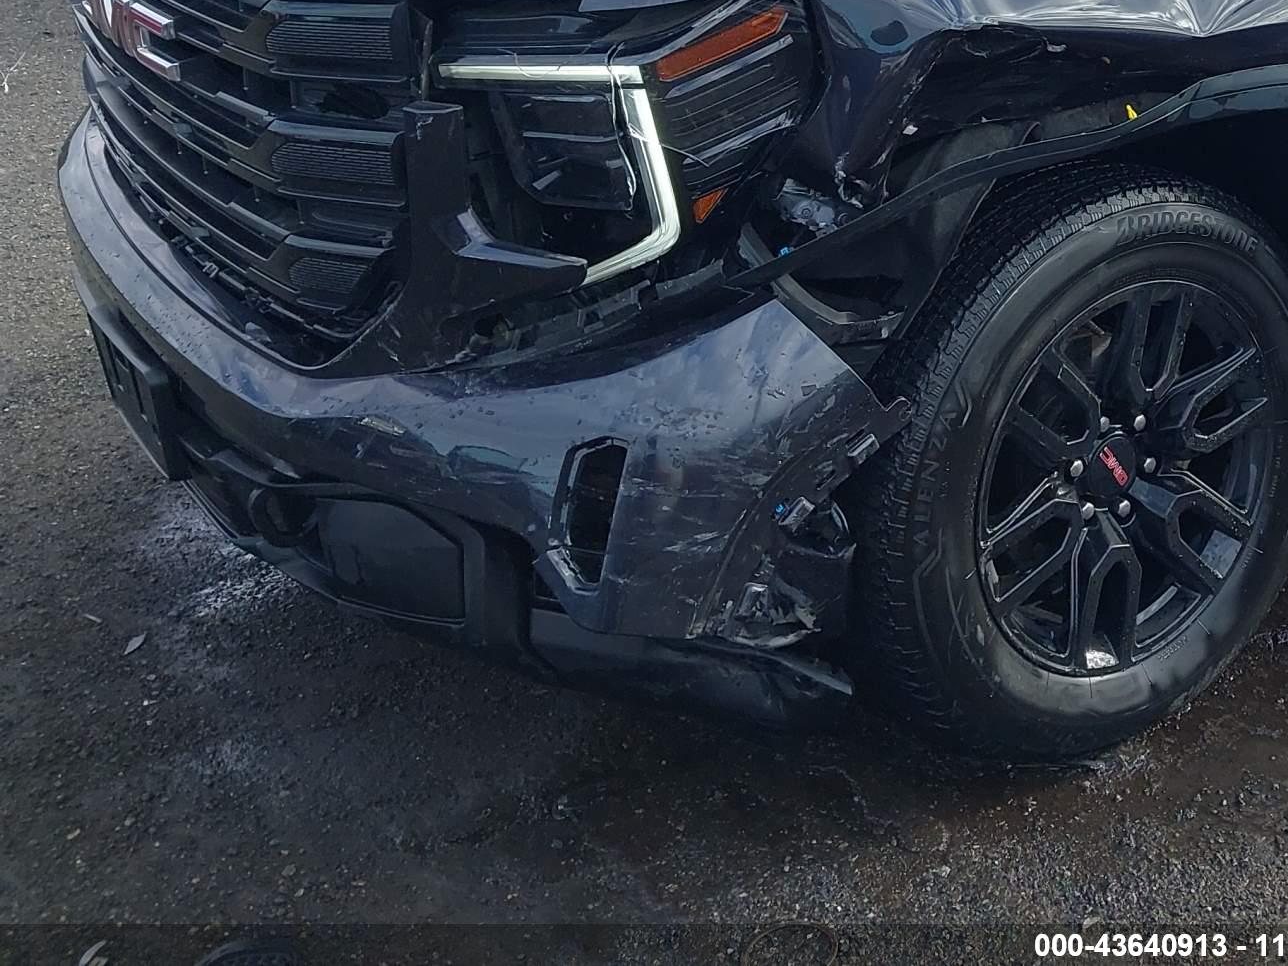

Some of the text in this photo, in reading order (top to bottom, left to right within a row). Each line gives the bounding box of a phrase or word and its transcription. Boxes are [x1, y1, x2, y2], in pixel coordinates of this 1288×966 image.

[1116, 209, 1259, 253] BRIDGESTONE
[912, 411, 958, 547] ALENZA
[1100, 446, 1128, 485] GMC
